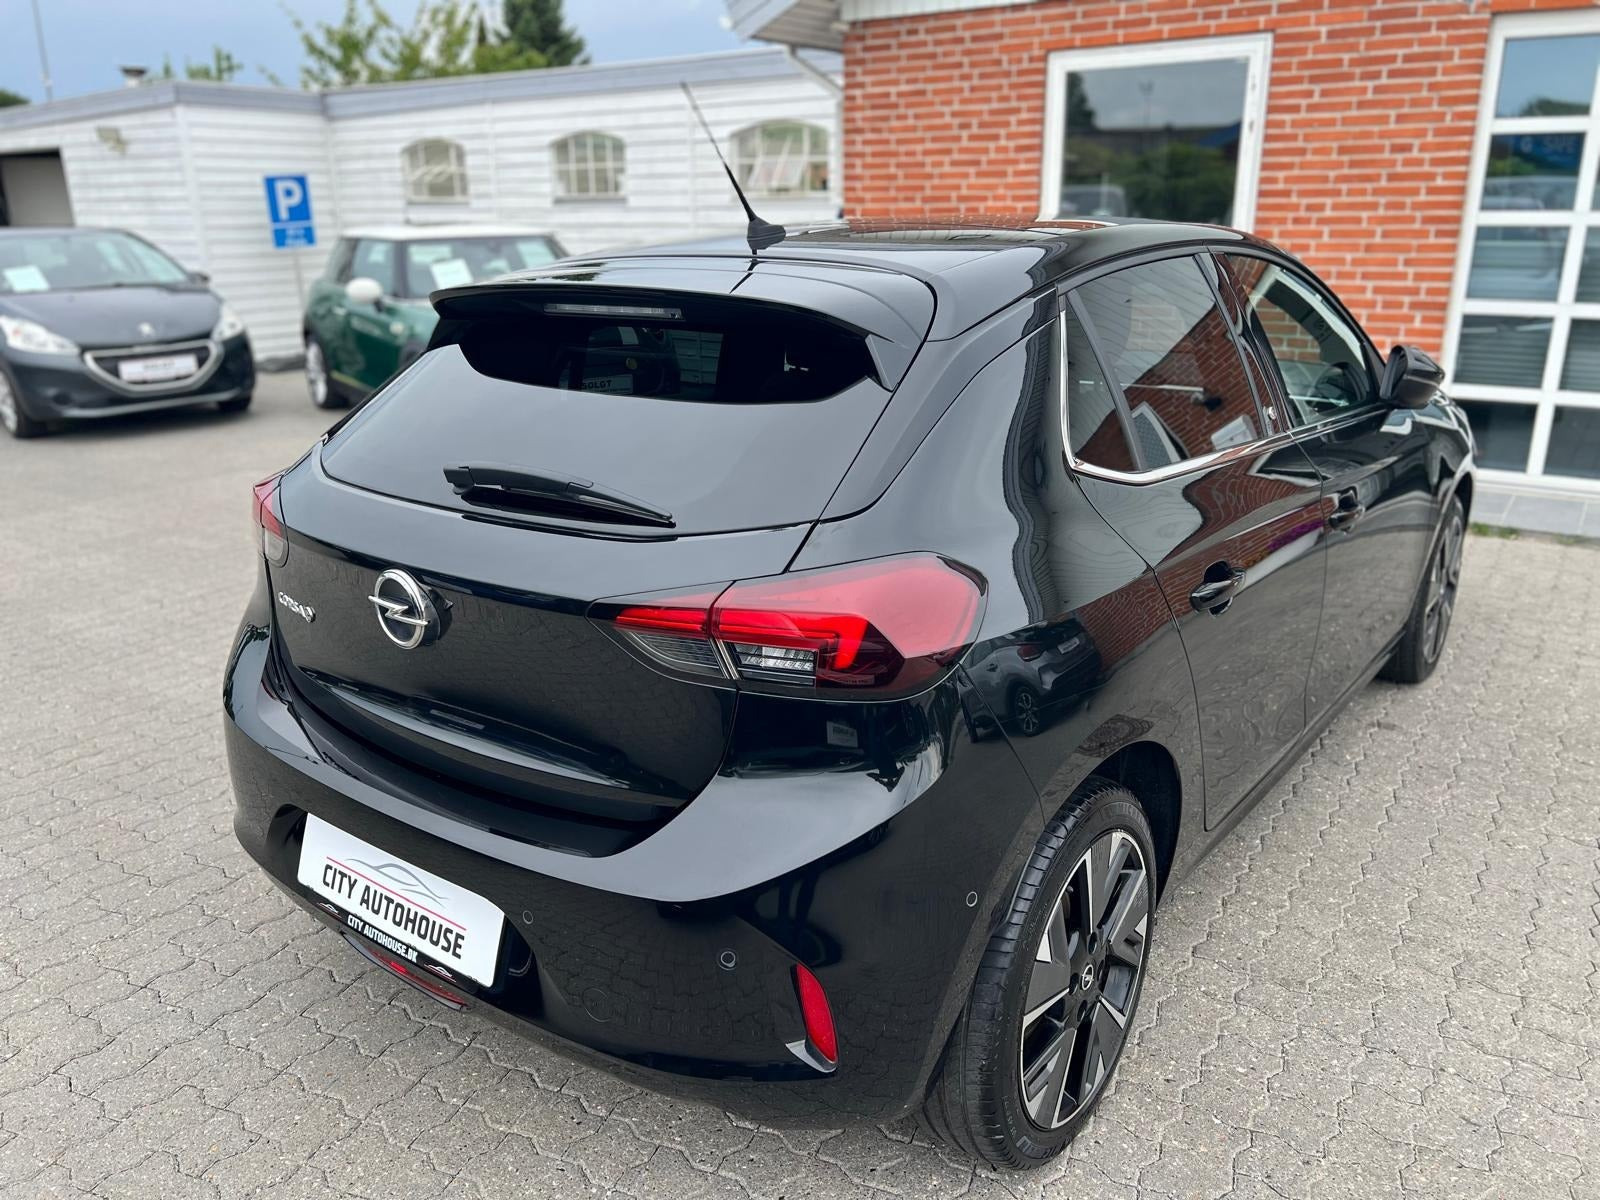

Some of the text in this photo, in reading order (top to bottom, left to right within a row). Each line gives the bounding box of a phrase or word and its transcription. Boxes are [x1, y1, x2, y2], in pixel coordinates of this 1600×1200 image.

[273, 180, 303, 220] P
[322, 863, 465, 960] CITY AUTOHOUSE
[347, 914, 418, 963] CITY AUTOHOUSE.DK
